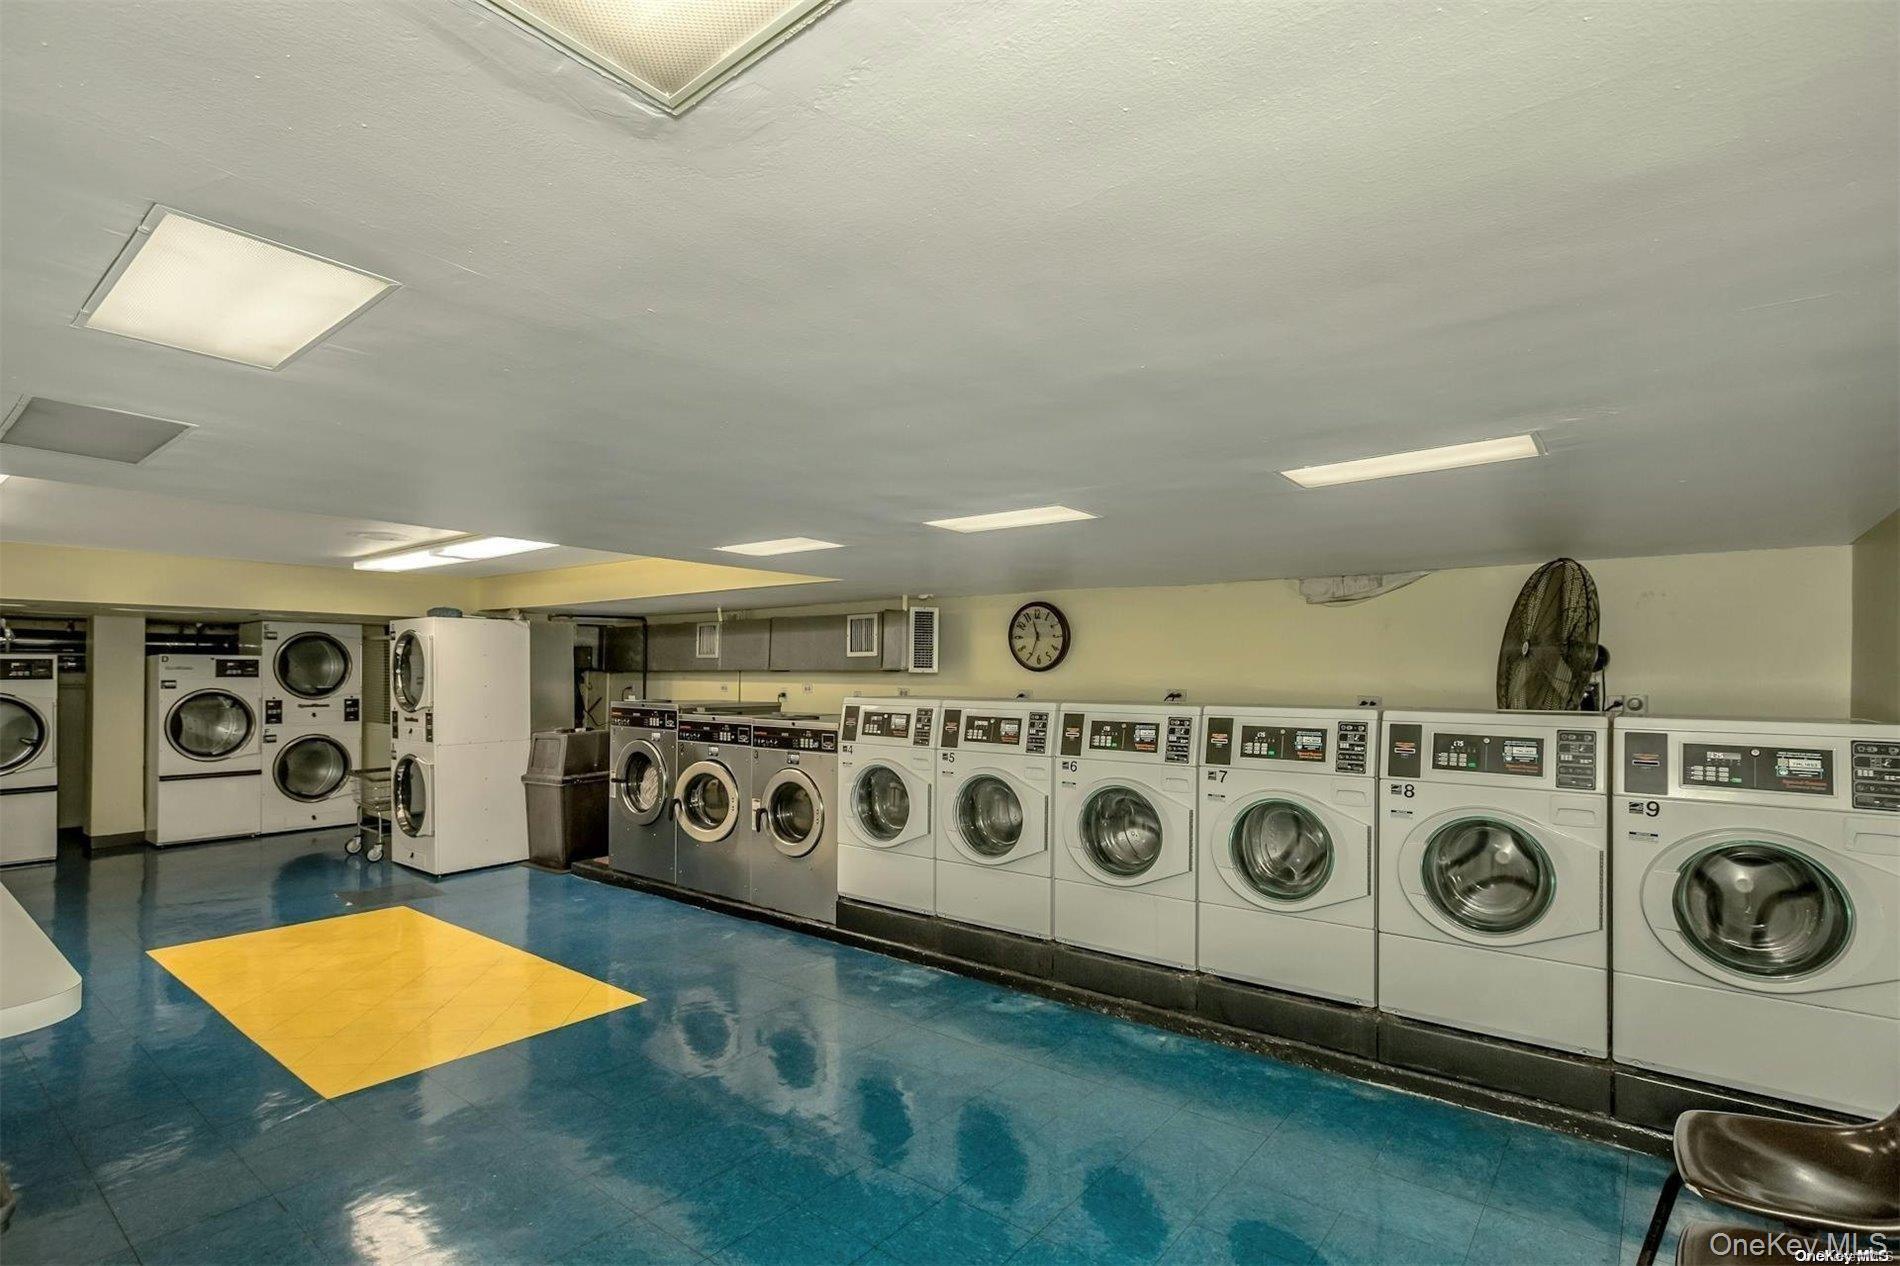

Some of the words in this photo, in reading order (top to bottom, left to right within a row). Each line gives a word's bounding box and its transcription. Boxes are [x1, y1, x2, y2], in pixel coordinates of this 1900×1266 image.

[161, 655, 169, 663] D
[847, 745, 853, 755] 4
[948, 752, 955, 763] 5
[1070, 761, 1078, 772] 6
[1219, 770, 1228, 783] 7
[1404, 783, 1415, 798] 8
[1646, 801, 1660, 817] 9
